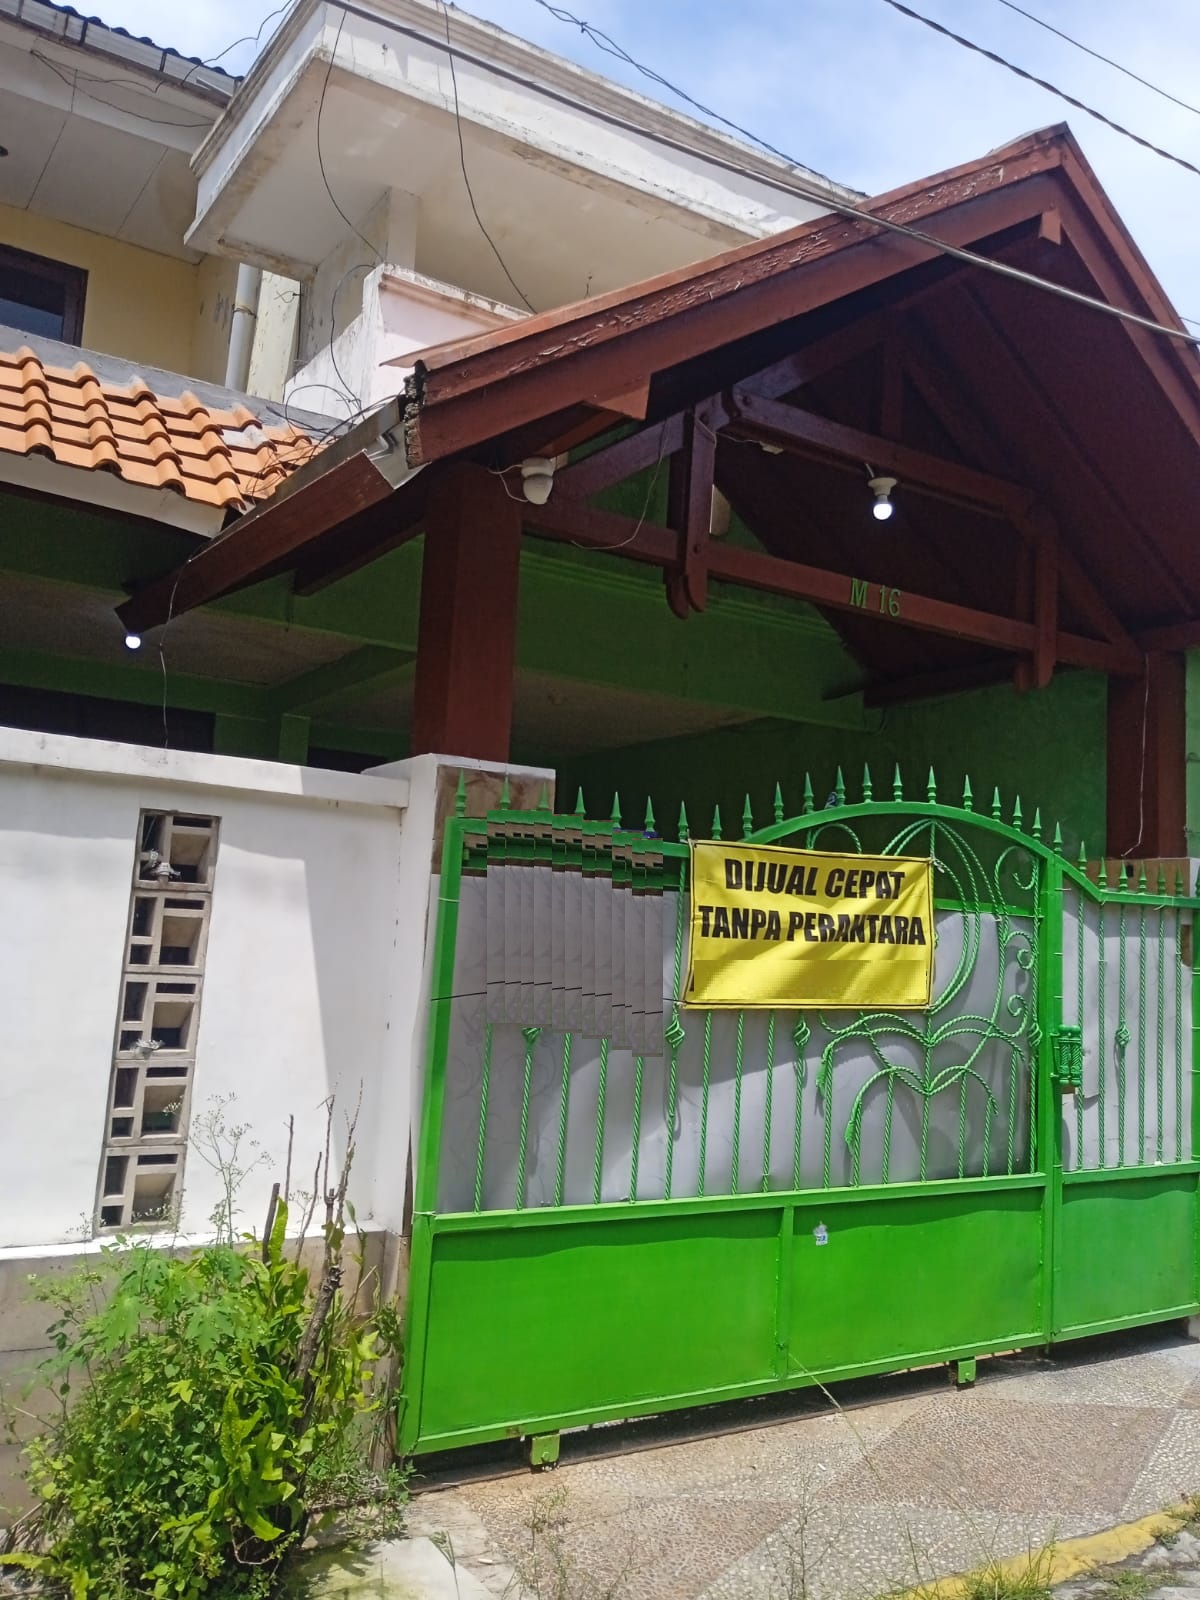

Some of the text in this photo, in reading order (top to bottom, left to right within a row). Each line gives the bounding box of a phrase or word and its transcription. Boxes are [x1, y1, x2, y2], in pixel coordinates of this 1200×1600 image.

[849, 577, 901, 617] M 16
[724, 858, 905, 900] DIJUAL CEPAT
[698, 905, 927, 945] TANPA PERANTARA
